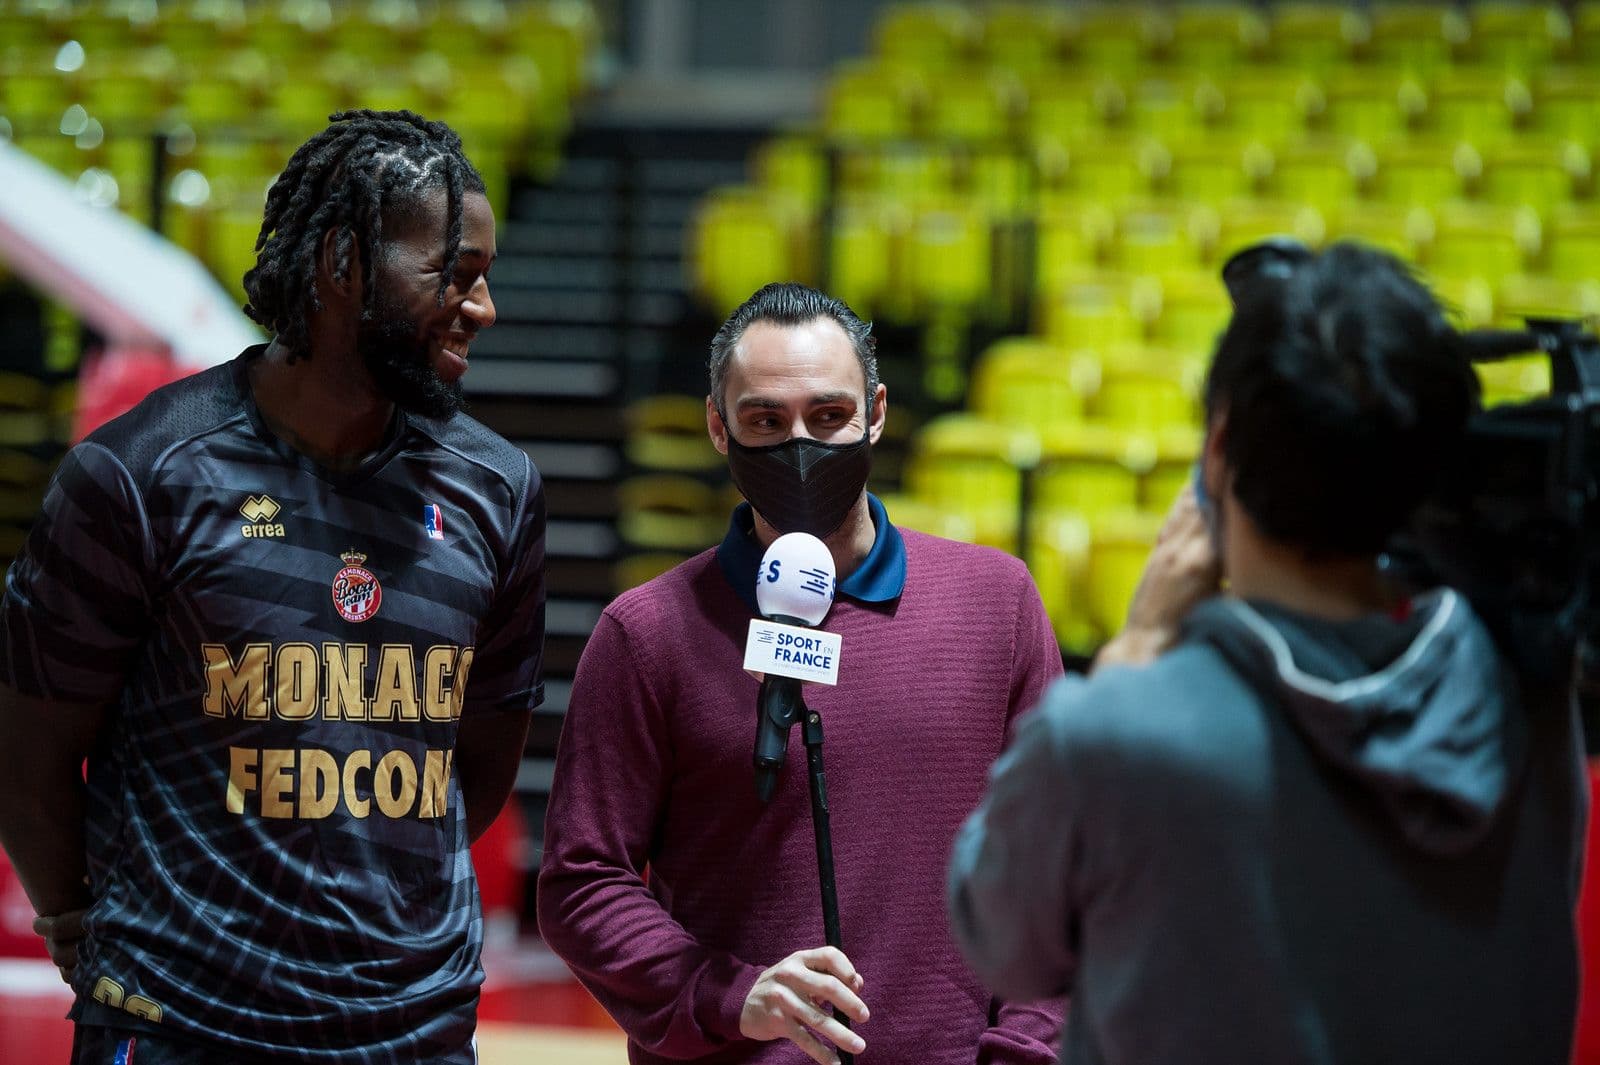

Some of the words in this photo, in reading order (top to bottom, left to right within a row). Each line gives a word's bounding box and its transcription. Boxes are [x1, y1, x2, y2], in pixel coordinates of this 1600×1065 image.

[241, 523, 285, 538] errea
[766, 560, 781, 583] S
[777, 633, 822, 651] SPORT
[824, 646, 834, 655] EN
[775, 648, 831, 669] FRANCE
